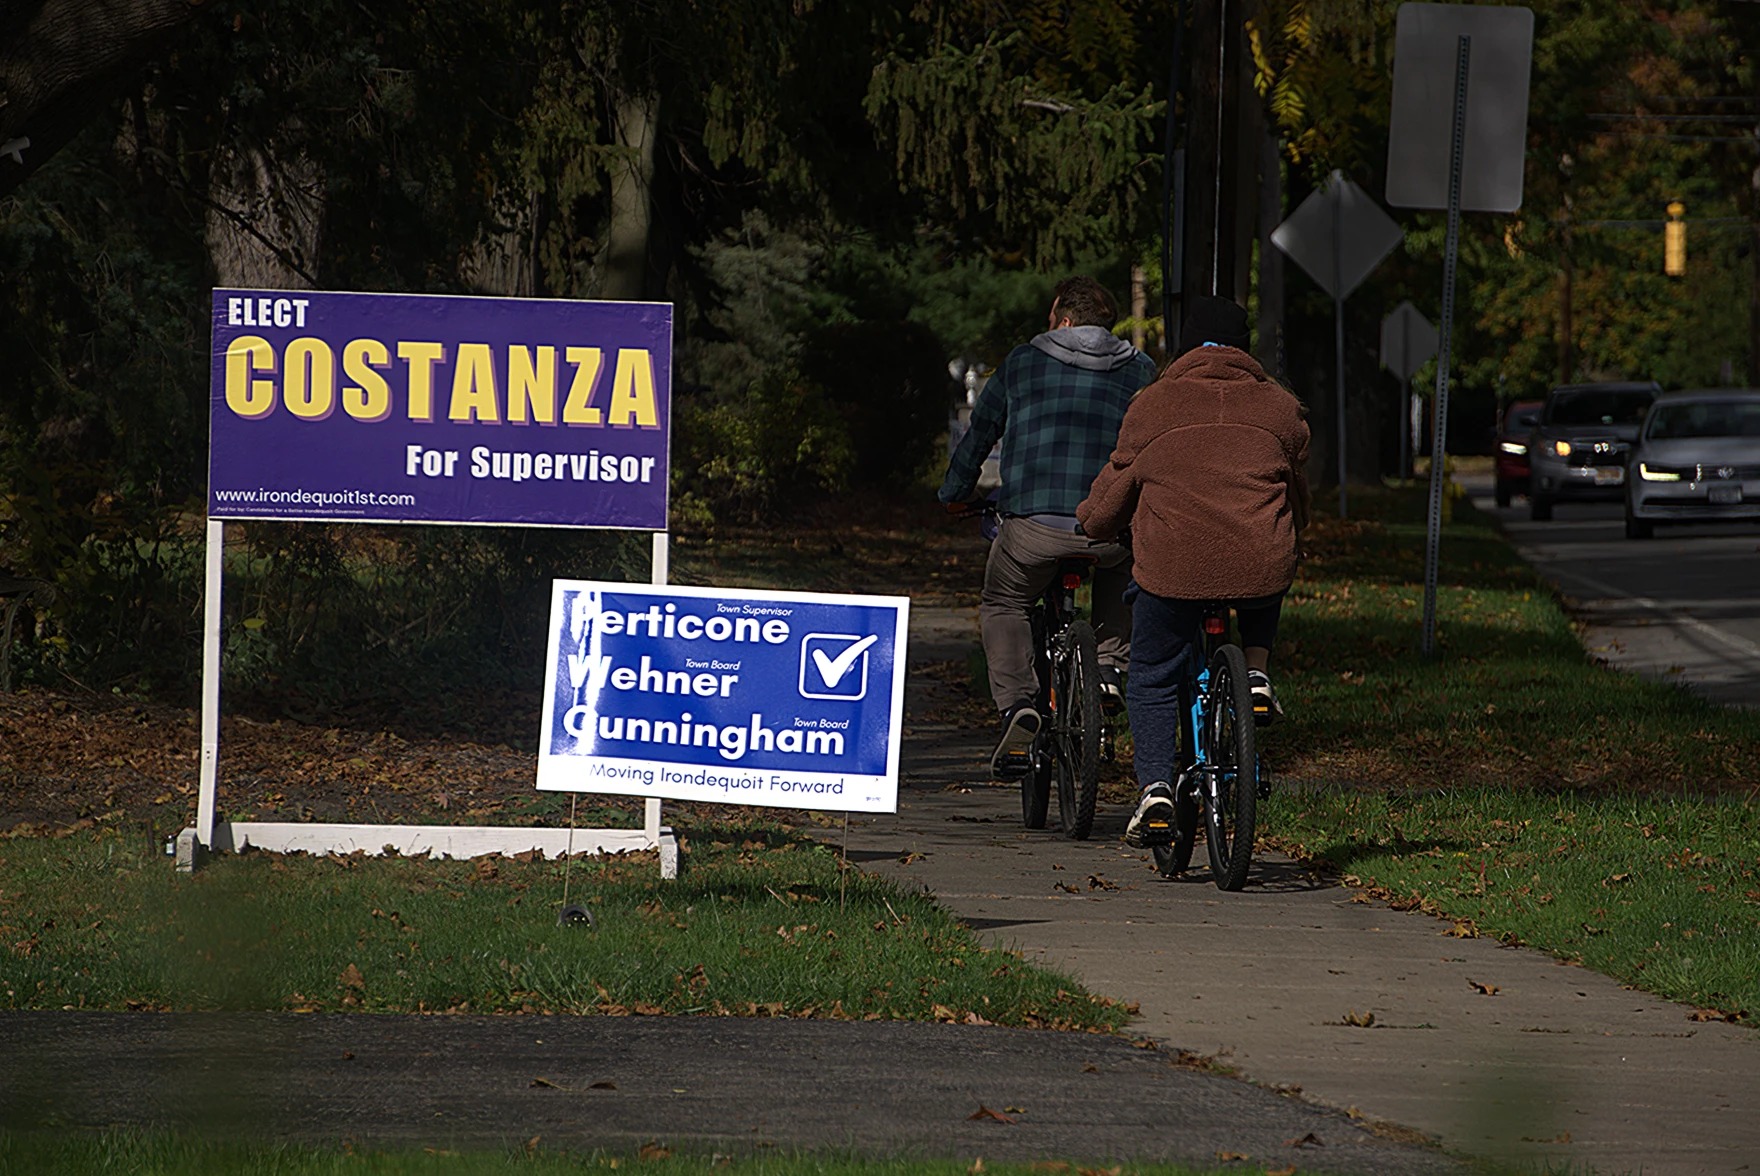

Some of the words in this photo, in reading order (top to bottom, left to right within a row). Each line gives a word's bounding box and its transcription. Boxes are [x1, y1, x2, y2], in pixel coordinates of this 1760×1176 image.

[228, 297, 310, 328] ELECT
[224, 335, 661, 431] COSTANZA
[405, 445, 459, 477] For
[470, 446, 656, 484] Supervisor
[214, 487, 416, 507] www.irondequoit1st.com
[716, 602, 740, 614] Town
[742, 604, 793, 617] Supervisor
[567, 654, 739, 698] Wehner
[684, 658, 709, 669] Town
[710, 659, 741, 671] Board
[793, 717, 817, 728] Town
[819, 718, 850, 730] Board
[589, 763, 654, 786] Moving
[660, 767, 764, 793] Irondequoit
[770, 775, 844, 795] Forward
